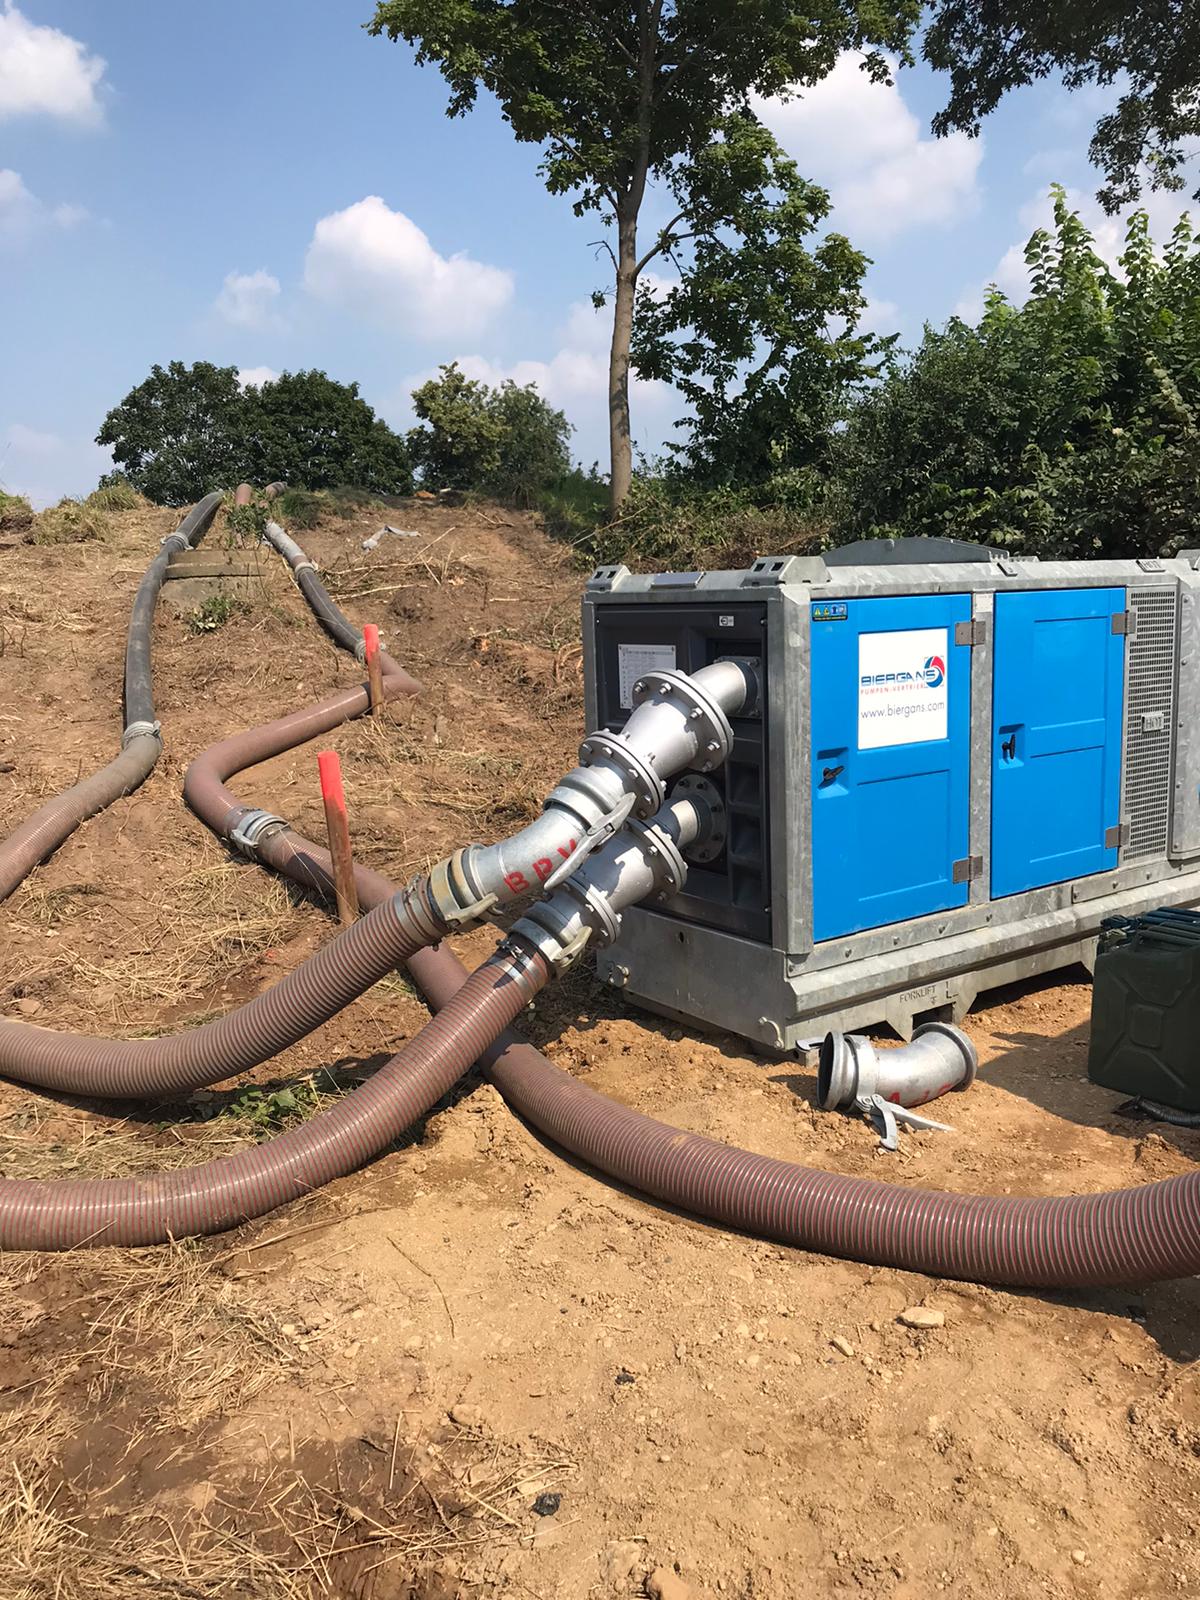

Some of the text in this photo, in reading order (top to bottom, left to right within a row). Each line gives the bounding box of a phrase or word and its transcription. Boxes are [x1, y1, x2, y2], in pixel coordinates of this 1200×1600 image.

[861, 669, 936, 687] BIERGANS
[861, 702, 945, 718] www.biergans.com
[1145, 716, 1163, 729] HOT
[900, 985, 937, 1003] FORKLIFT
